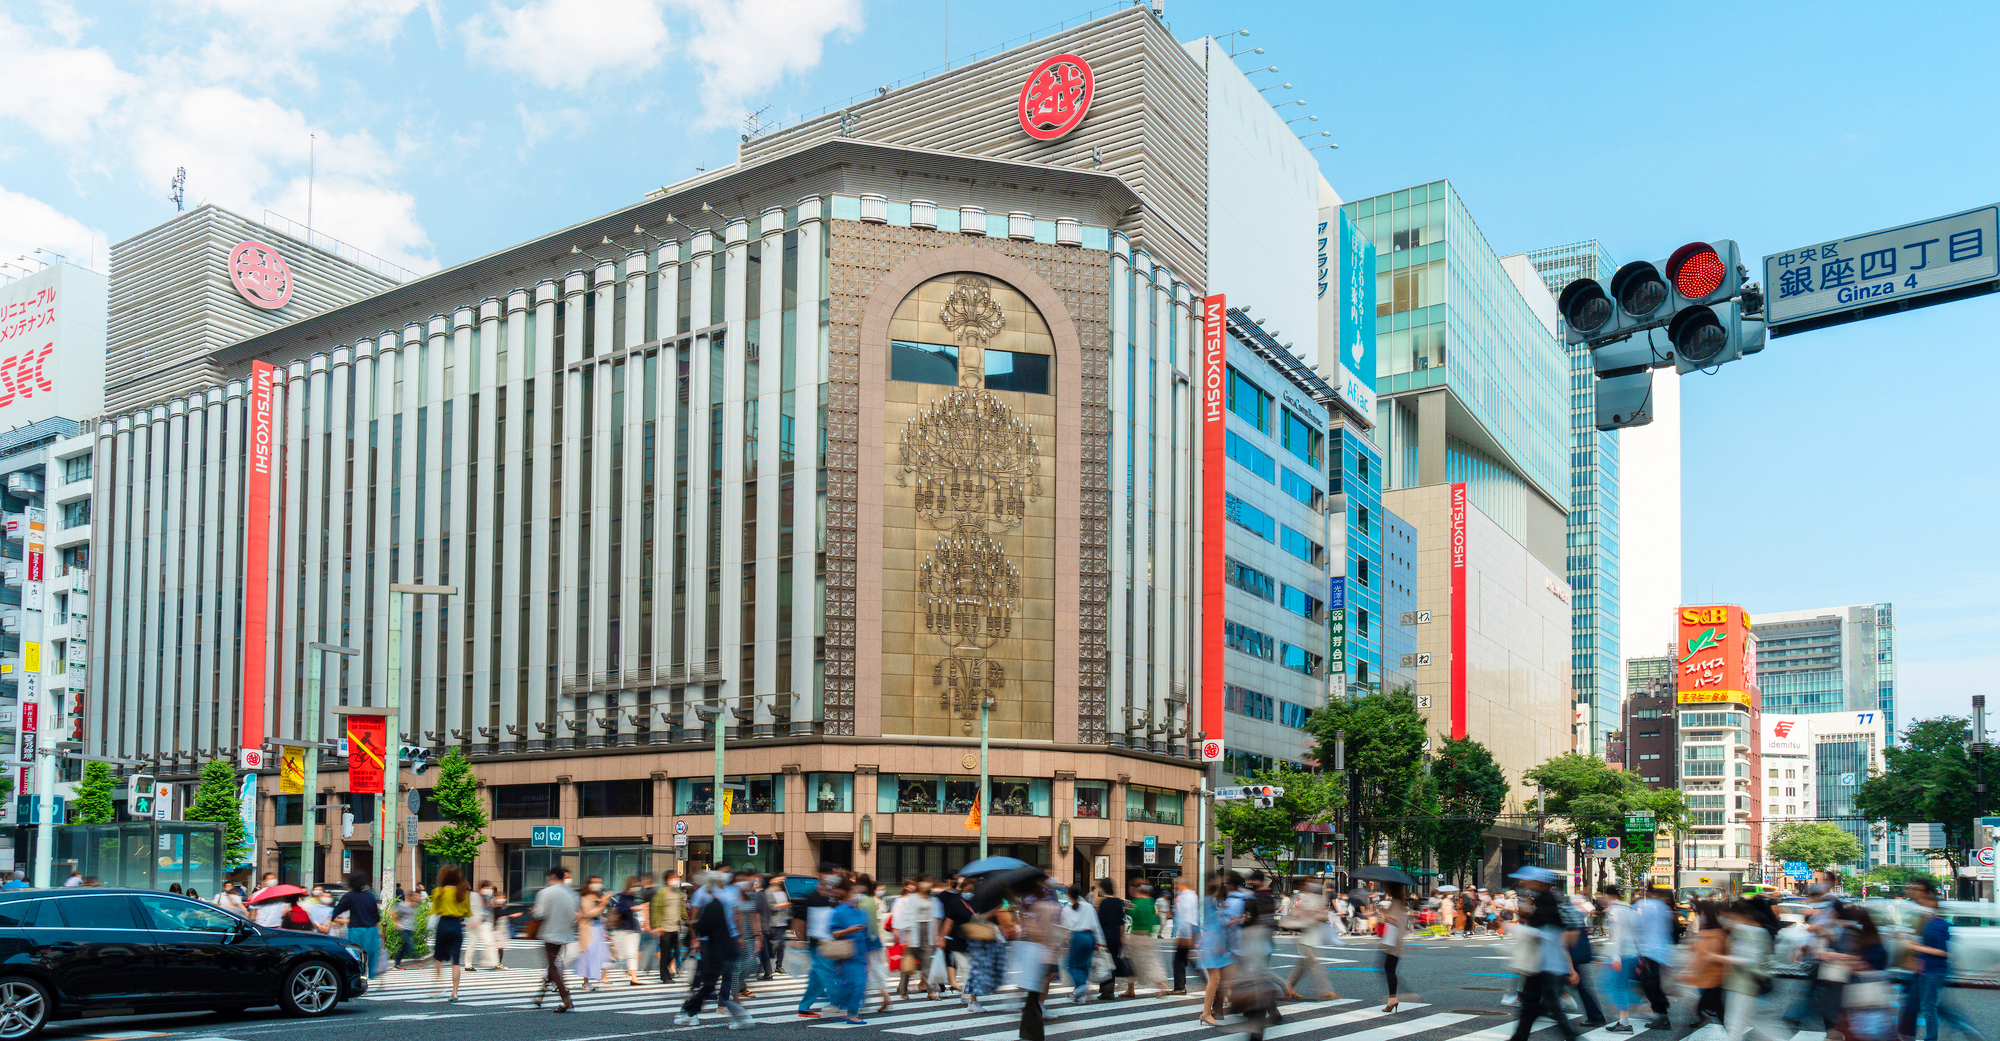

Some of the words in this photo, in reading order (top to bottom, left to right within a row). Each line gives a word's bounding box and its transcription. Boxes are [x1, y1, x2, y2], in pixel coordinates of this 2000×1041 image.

[1318, 221, 1328, 299] アフラック
[1778, 242, 1839, 269] 中央区
[1779, 228, 1983, 299] 銀座四丁目
[0, 286, 56, 322] リニューアル
[1837, 281, 1895, 304] Ginza
[1903, 273, 1919, 289] 4
[0, 307, 55, 343] メンテナンス
[1207, 302, 1221, 423] MITSUKOSHI
[1347, 378, 1369, 413] Aflac
[255, 368, 271, 474] MITSUKOSHI
[1454, 488, 1464, 568] MITSUKOSHI
[1682, 607, 1728, 625] S&B
[1686, 657, 1725, 674] スパイス
[1703, 669, 1713, 678] &
[1856, 713, 1874, 725] 77
[1768, 738, 1801, 750] idemitsu
